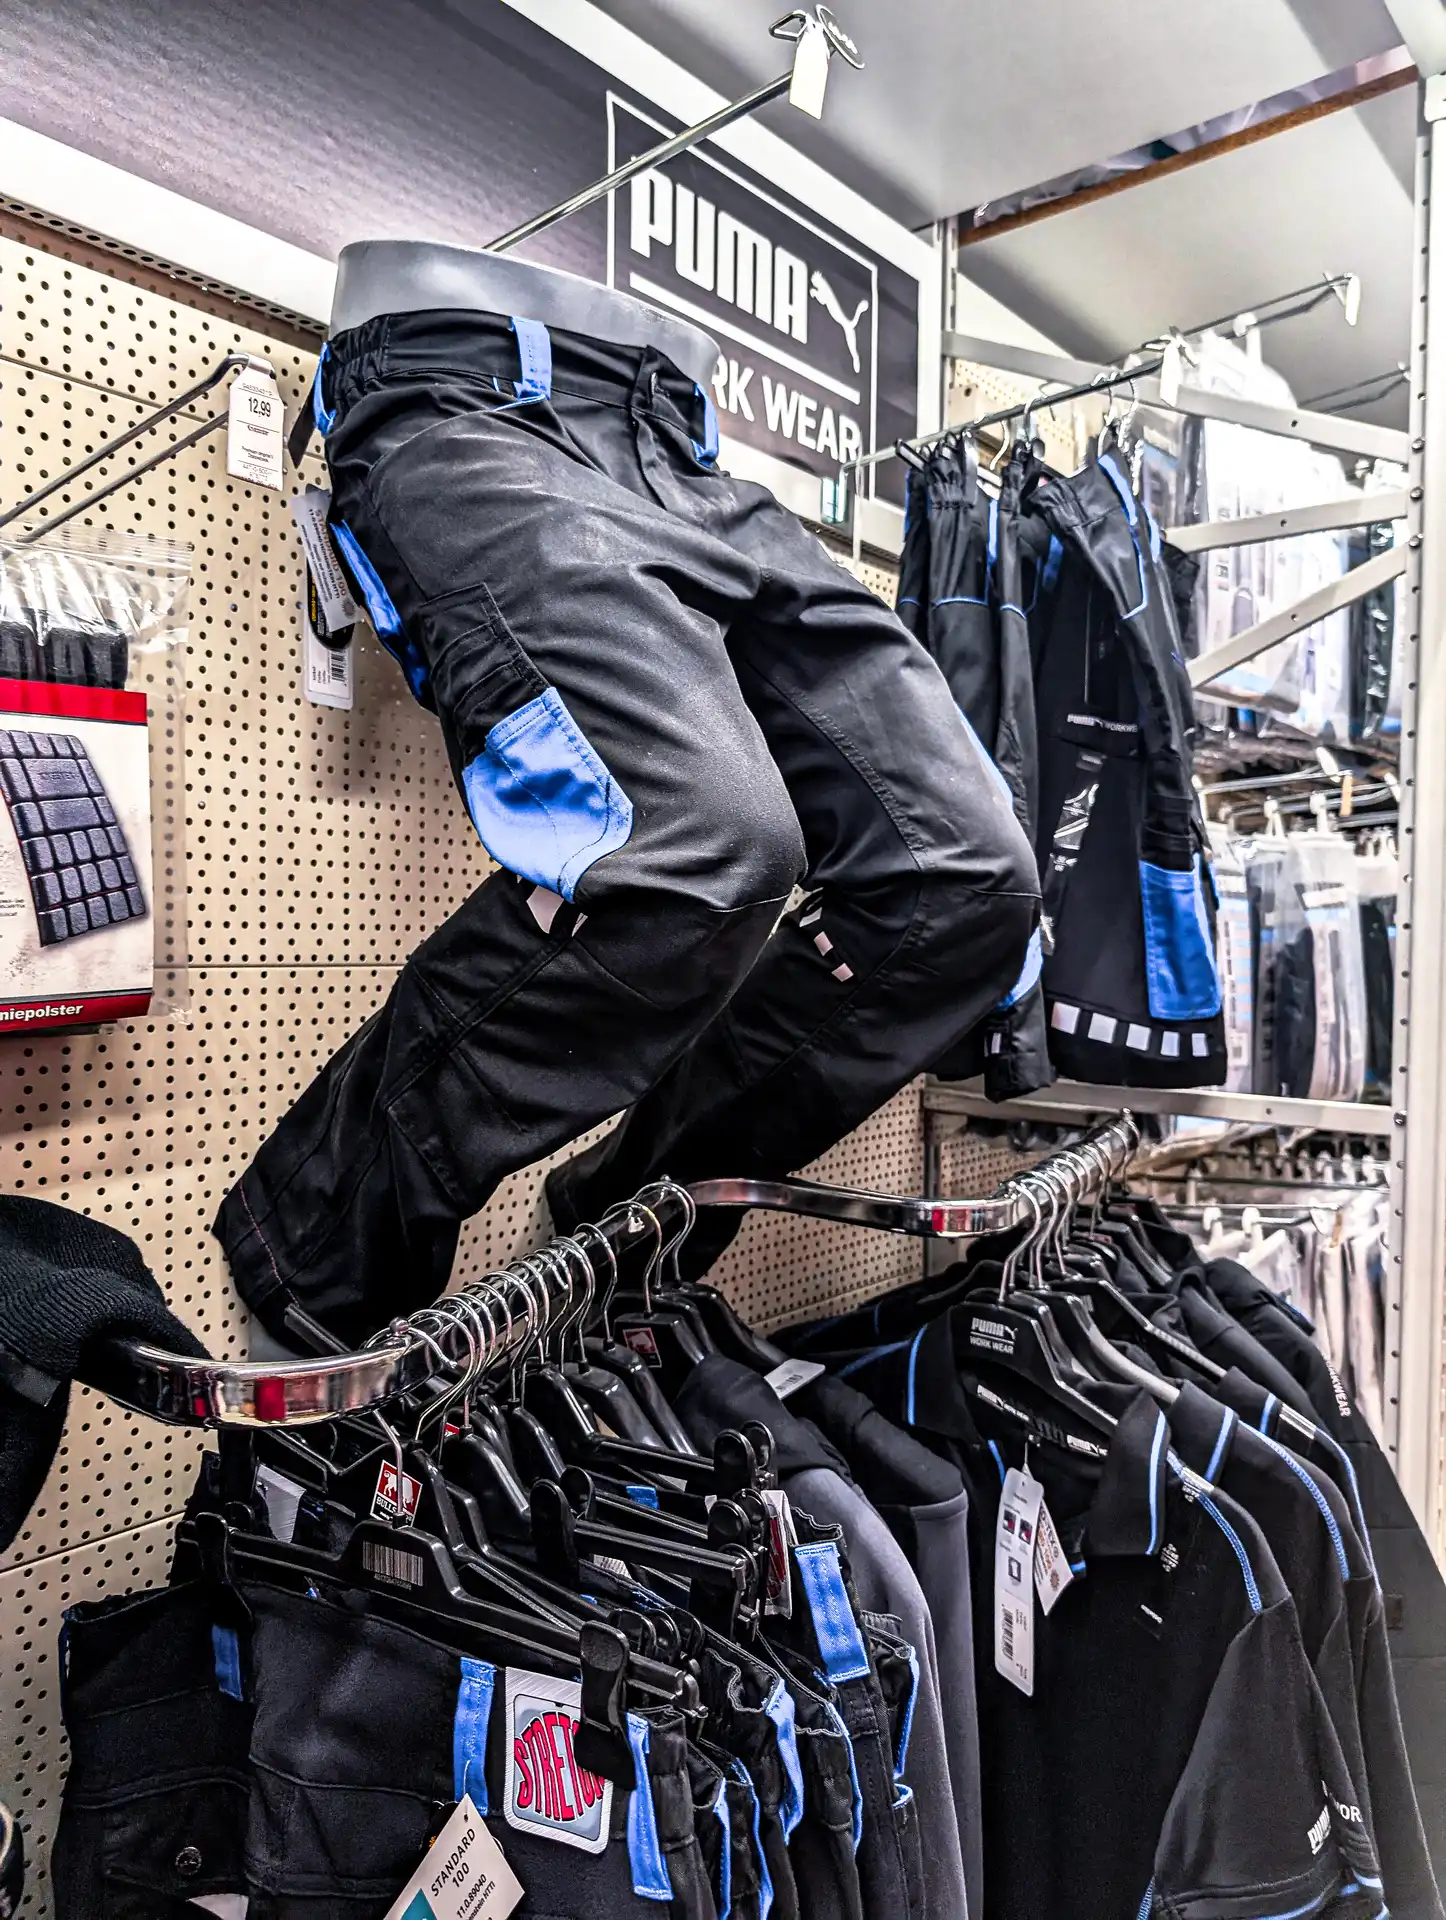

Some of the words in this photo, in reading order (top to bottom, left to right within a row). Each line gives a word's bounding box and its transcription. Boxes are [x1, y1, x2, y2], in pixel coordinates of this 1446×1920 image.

[630, 158, 808, 344] PUMA
[248, 397, 271, 417] 12.99
[712, 354, 754, 422] RK
[761, 375, 861, 463] WEAR
[0, 1005, 83, 1021] niepolster
[972, 1317, 1004, 1337] PUMA
[431, 1828, 476, 1897] STANDARD
[452, 1862, 470, 1888] 100
[456, 1873, 487, 1919] 11.0.89040
[468, 1897, 486, 1920] enstein
[482, 1880, 496, 1900] HTTI
